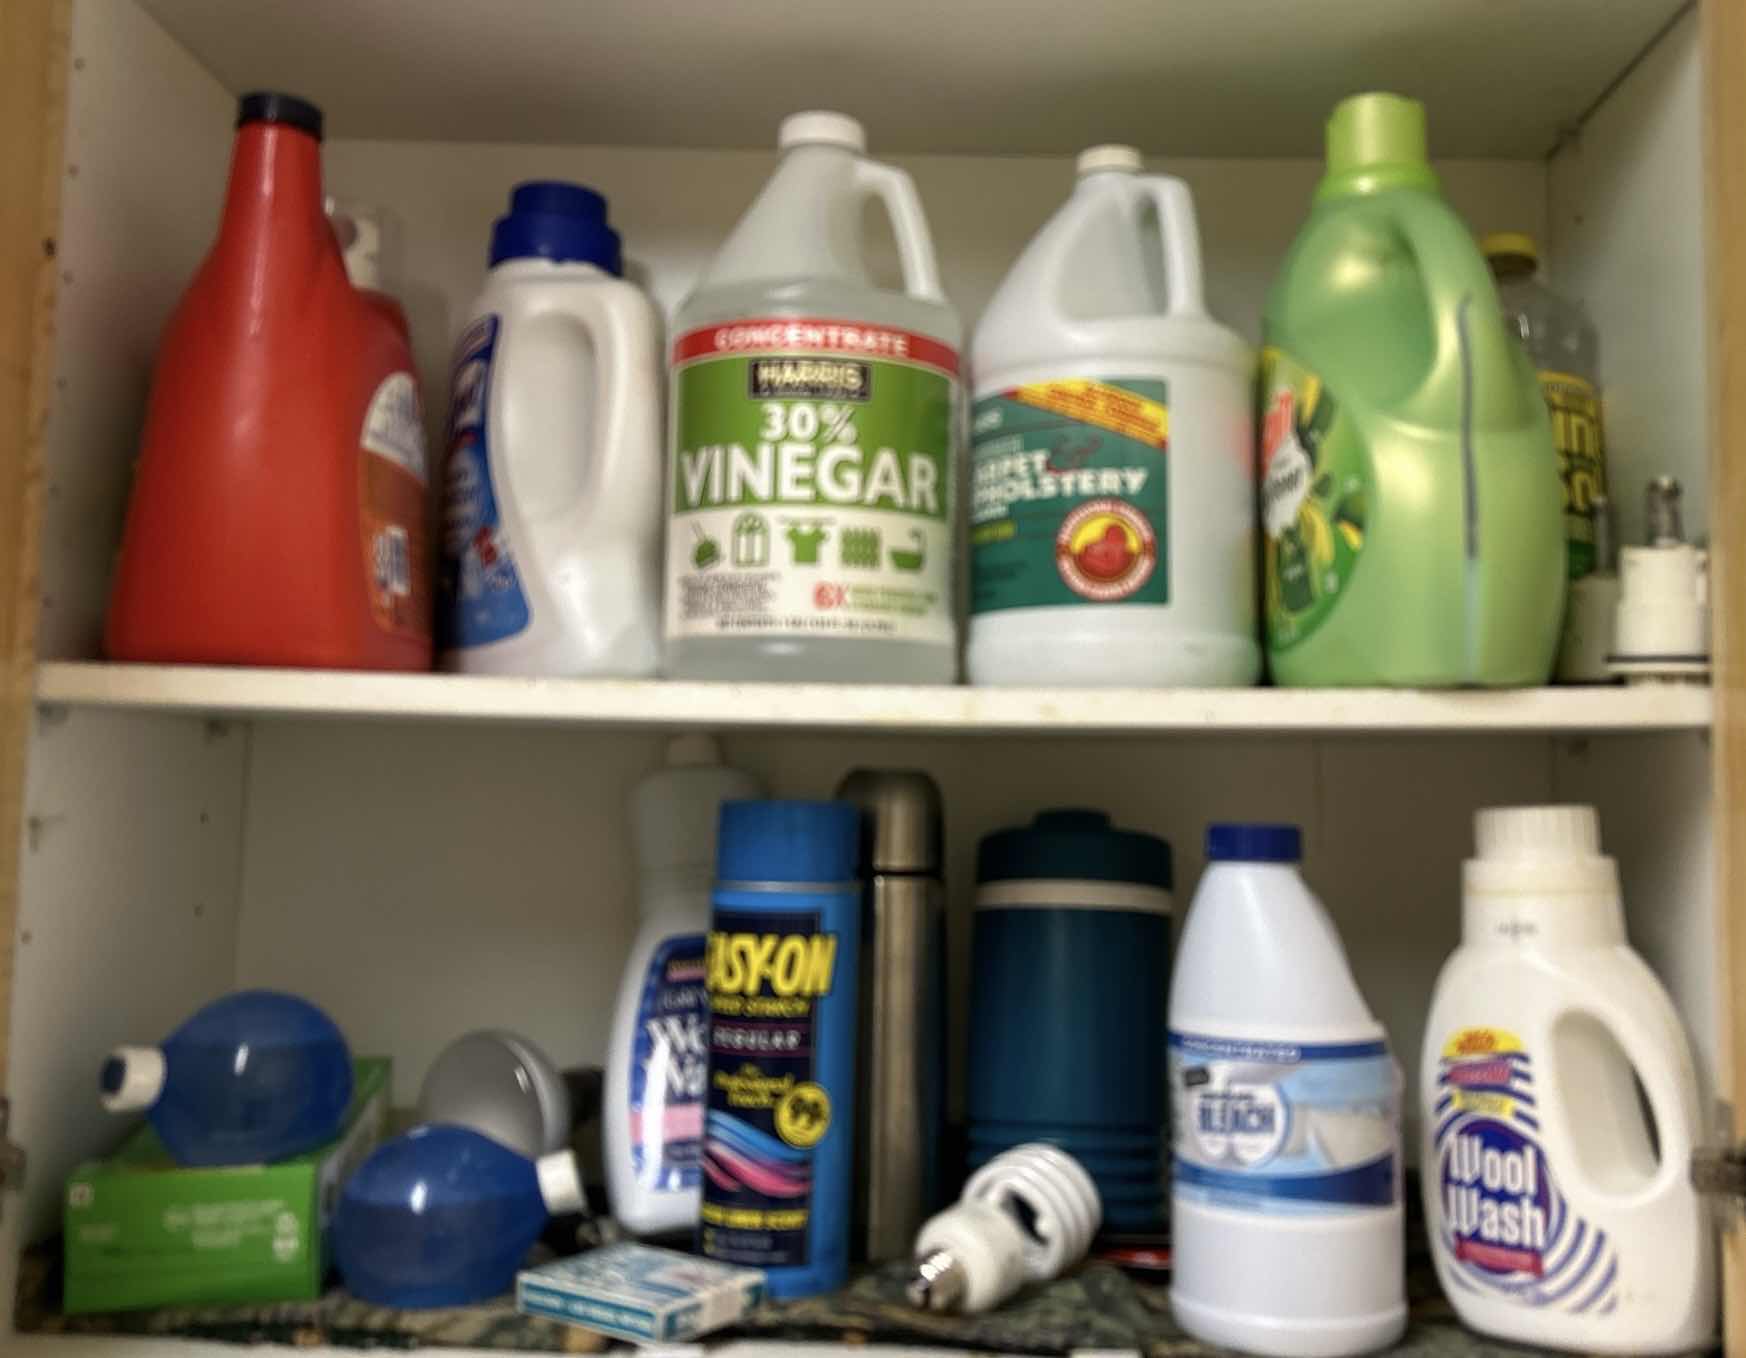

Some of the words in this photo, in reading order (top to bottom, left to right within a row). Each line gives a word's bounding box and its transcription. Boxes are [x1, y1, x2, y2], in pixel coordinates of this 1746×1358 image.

[713, 321, 909, 354] CONCENTRATE
[756, 361, 863, 387] HARRIS
[761, 402, 858, 444] 30%
[680, 441, 940, 513] VINEGAR
[713, 1026, 802, 1052] REGULAR
[1448, 1133, 1537, 1195] Wool
[1446, 1186, 1544, 1250] Wash
